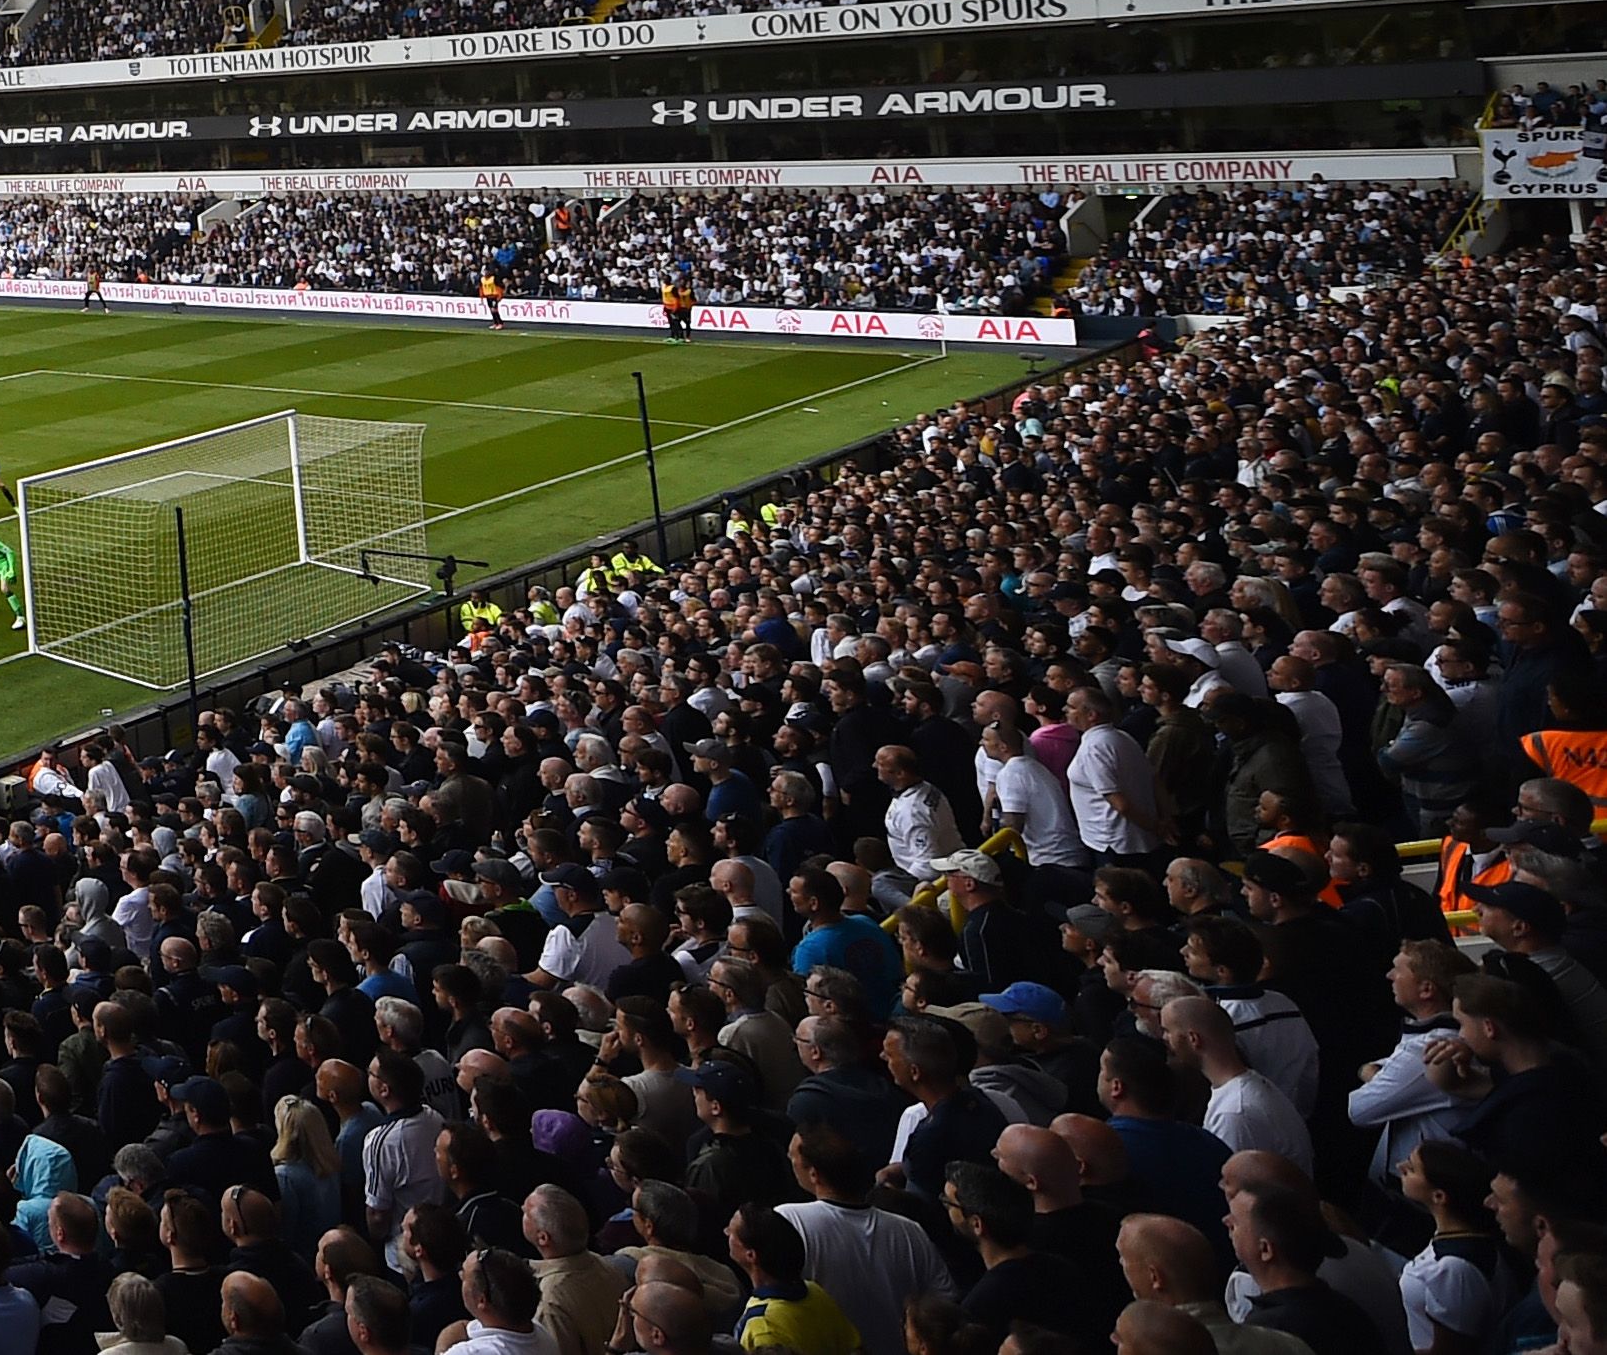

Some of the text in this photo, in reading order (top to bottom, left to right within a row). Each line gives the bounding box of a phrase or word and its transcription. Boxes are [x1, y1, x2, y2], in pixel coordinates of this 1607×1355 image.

[751, 9, 829, 38] COME
[839, 5, 880, 32] ON
[889, 0, 954, 28] YOU
[447, 23, 655, 58] TO DARE IS TO DO
[167, 45, 371, 76] TOTTENHAM HOTSPUR
[707, 95, 862, 123] UNDER
[289, 112, 398, 135] UNDER
[475, 172, 514, 188] AIA
[584, 168, 782, 187] THE REAL LIFE COMPANY
[871, 166, 924, 184] AIA
[1020, 160, 1294, 183] THE REAL LIFE COMPANY
[5, 178, 125, 193] THE REAL LIFE COMPANY
[176, 177, 207, 192] AIA
[261, 174, 408, 191] THE REAL LIFE COMPANY
[1509, 184, 1598, 194] CYPRUS
[698, 309, 749, 329] AIA
[831, 314, 889, 335] AIA
[978, 319, 1040, 341] AIA
